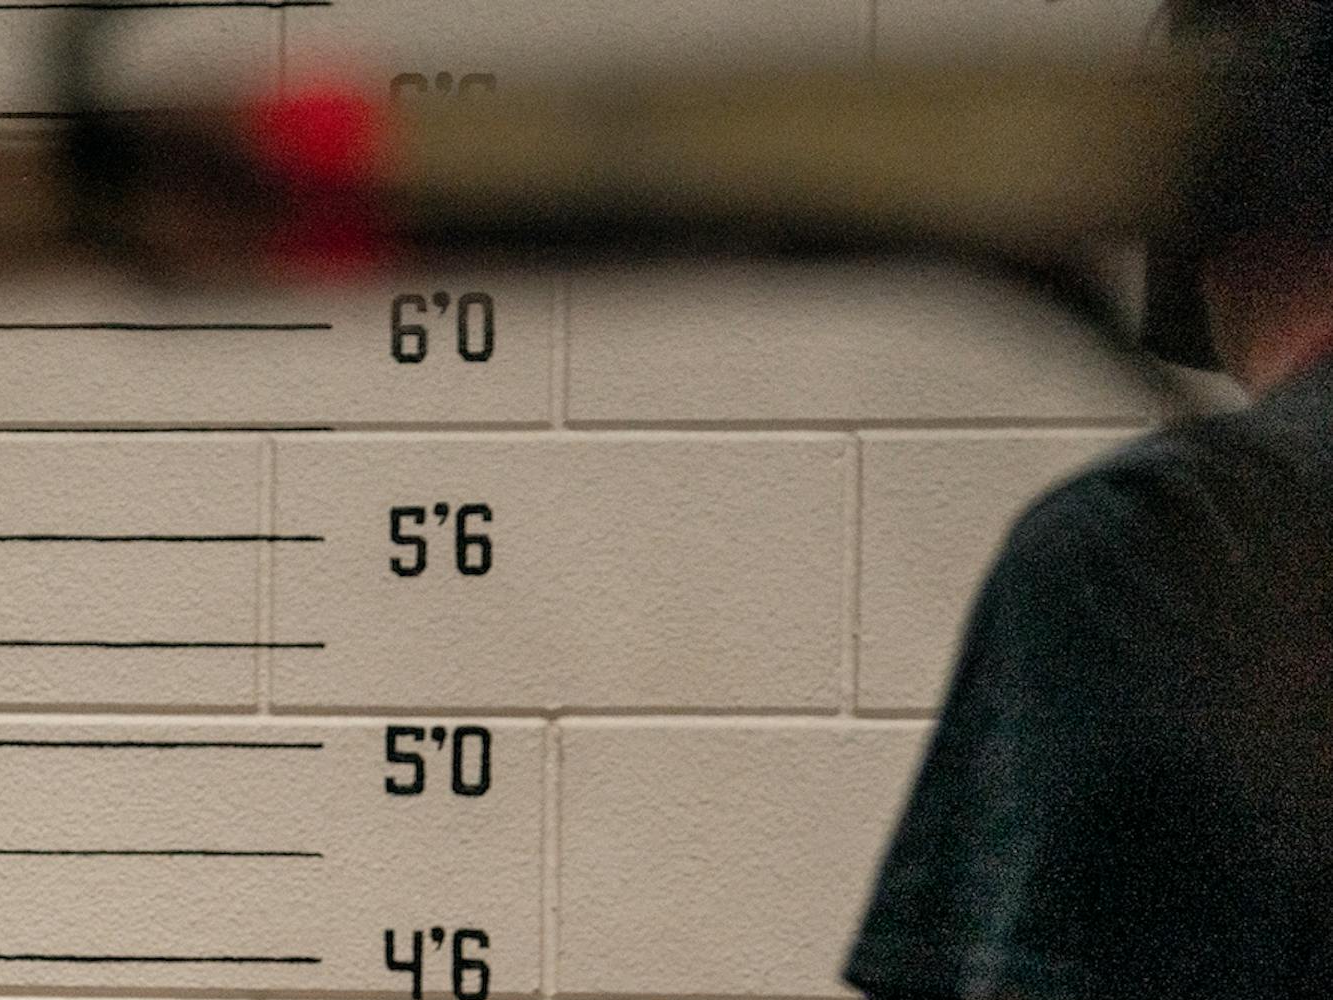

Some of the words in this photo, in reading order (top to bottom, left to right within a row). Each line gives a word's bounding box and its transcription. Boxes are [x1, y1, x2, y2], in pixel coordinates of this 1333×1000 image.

[390, 290, 495, 364] 6'0
[389, 503, 494, 578] 5'6
[384, 725, 492, 798] 5'0
[384, 926, 491, 1000] 4'6
